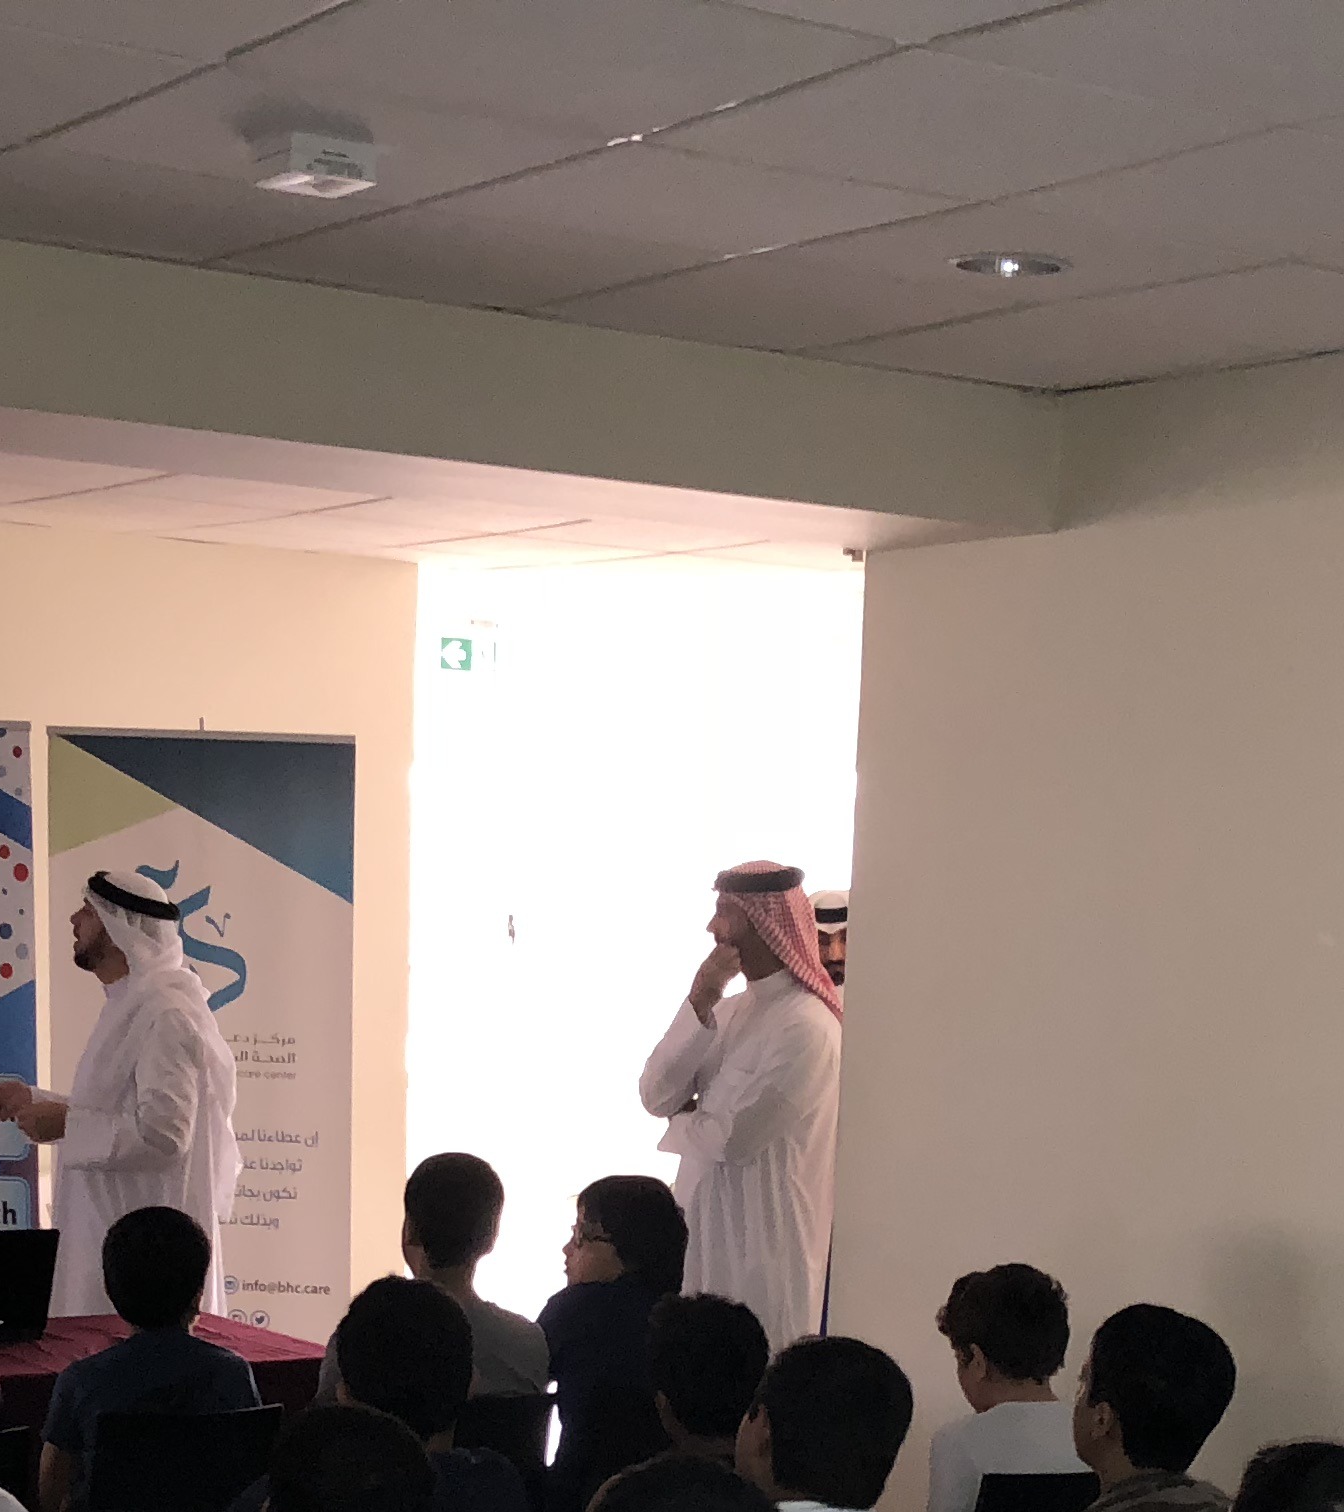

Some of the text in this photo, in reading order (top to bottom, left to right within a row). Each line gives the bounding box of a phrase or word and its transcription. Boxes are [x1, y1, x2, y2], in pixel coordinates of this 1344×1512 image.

[259, 1158, 303, 1174] تواجدنا
[235, 1185, 261, 1201] بجان
[242, 1279, 331, 1296] info@bhc.care
